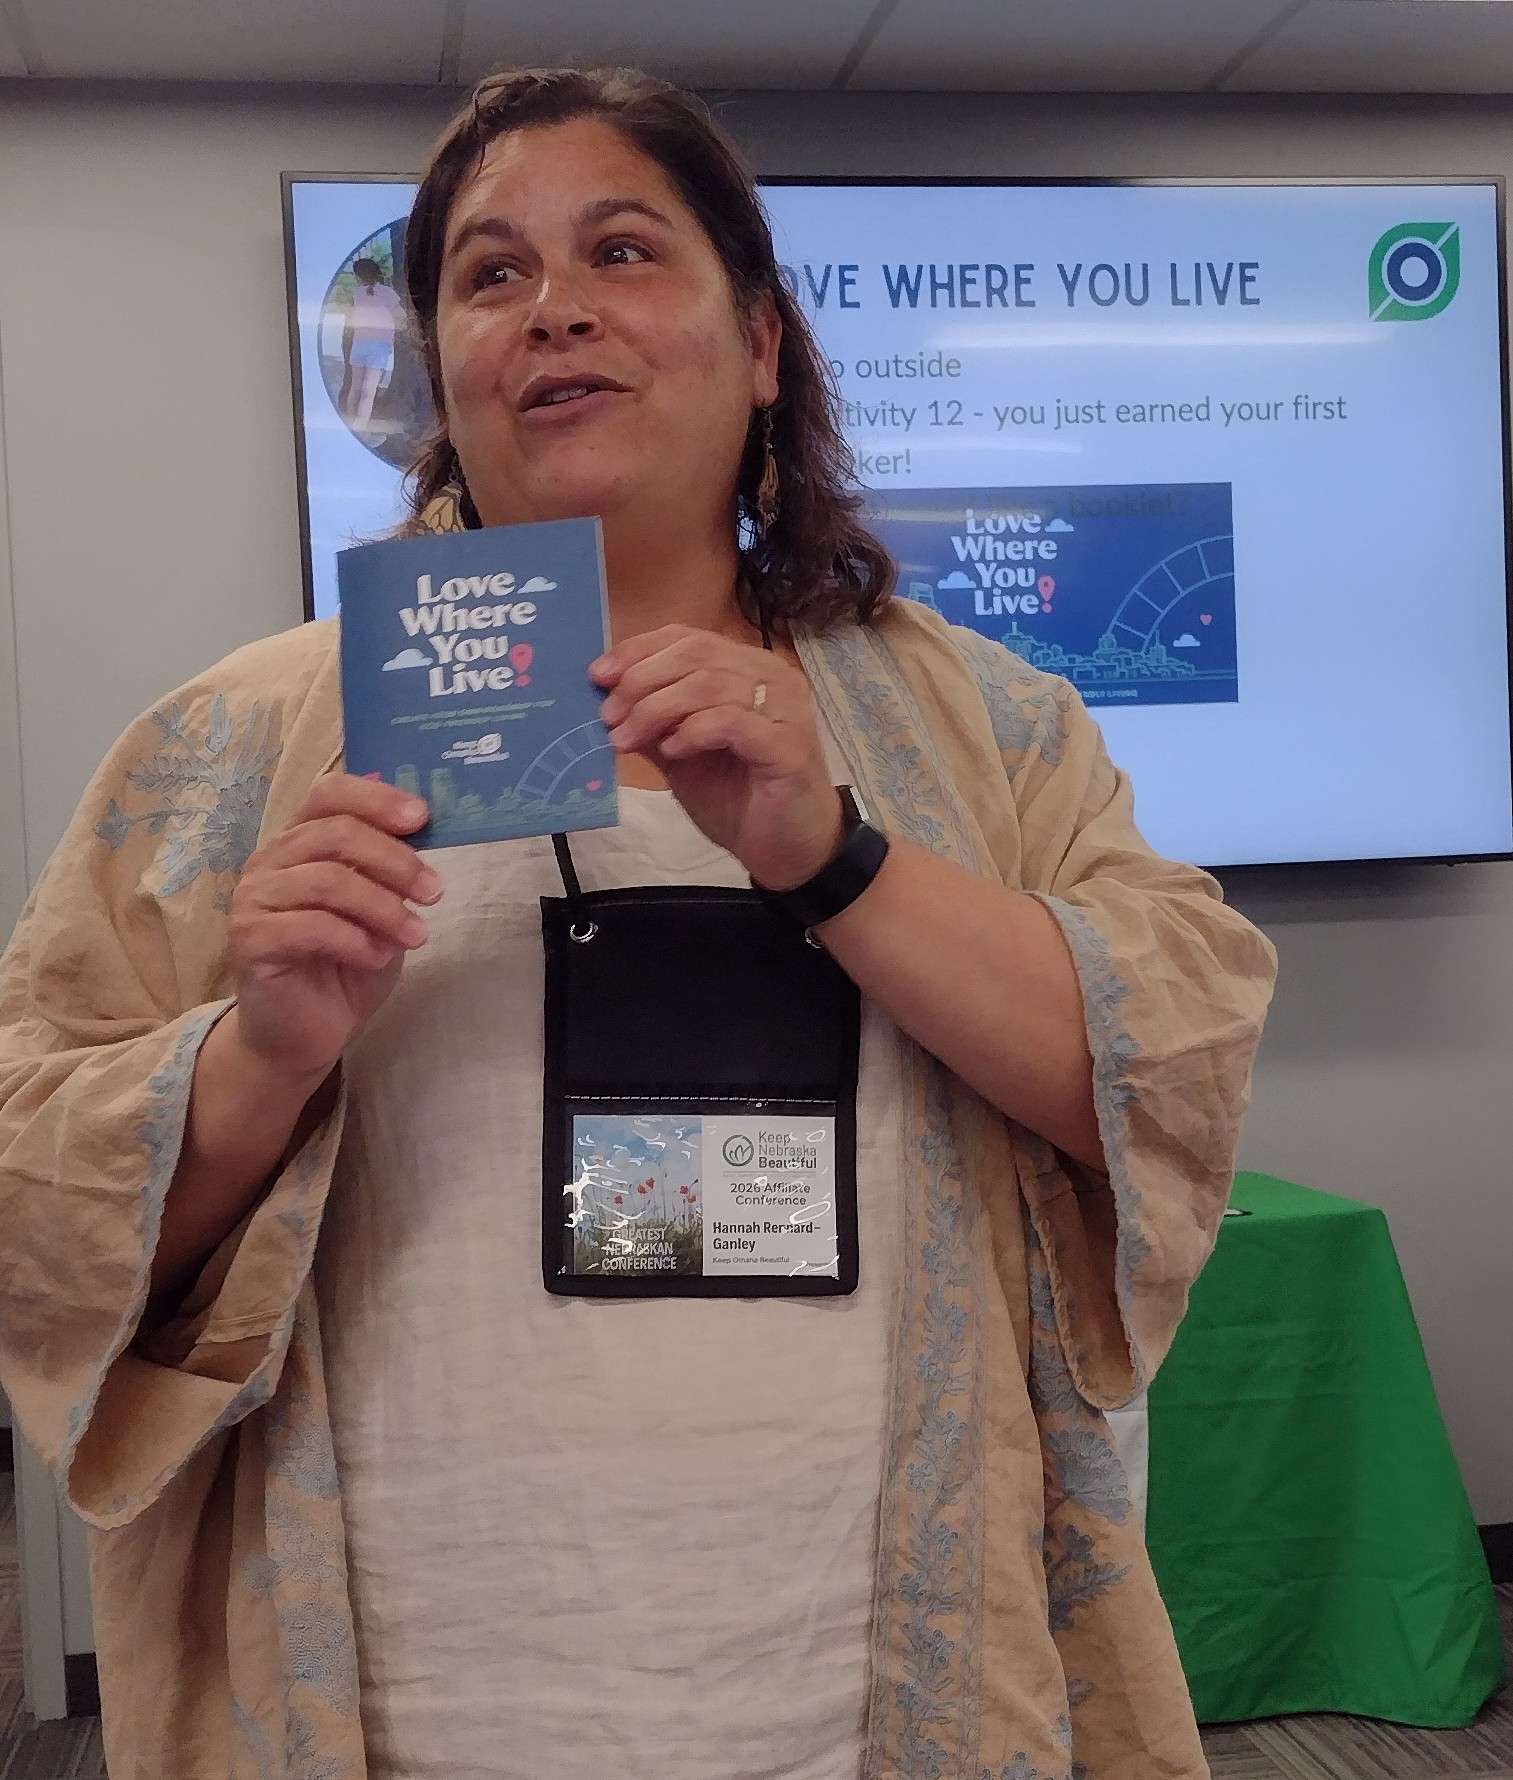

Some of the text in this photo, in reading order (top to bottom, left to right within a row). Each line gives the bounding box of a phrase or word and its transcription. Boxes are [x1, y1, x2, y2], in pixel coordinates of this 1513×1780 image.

[882, 263, 1035, 309] WHERE
[1056, 262, 1149, 307] YOU
[1170, 261, 1260, 306] LIVE
[856, 351, 962, 378] outside
[845, 401, 917, 433] tivity
[927, 400, 964, 426] 12
[993, 404, 1046, 432] you
[1053, 398, 1107, 430] just
[1115, 396, 1211, 423] earned
[1220, 401, 1284, 427] your
[1293, 394, 1348, 420] first
[858, 448, 911, 474] ker!
[965, 508, 1042, 534] Love
[950, 535, 1058, 562] Where
[416, 571, 516, 604] Love
[974, 562, 1036, 589] You
[399, 600, 538, 637] Where
[428, 633, 510, 665] You
[759, 1131, 791, 1146] Keep
[759, 1144, 817, 1157] Nebraska
[758, 1157, 817, 1169] Beautiful
[730, 1183, 760, 1193] 2026
[735, 1195, 807, 1206] Conference
[713, 1222, 760, 1234] Hannah
[603, 1242, 674, 1255] NEASKAN
[713, 1238, 756, 1253] Ganley
[601, 1256, 677, 1270] CONFERENCE
